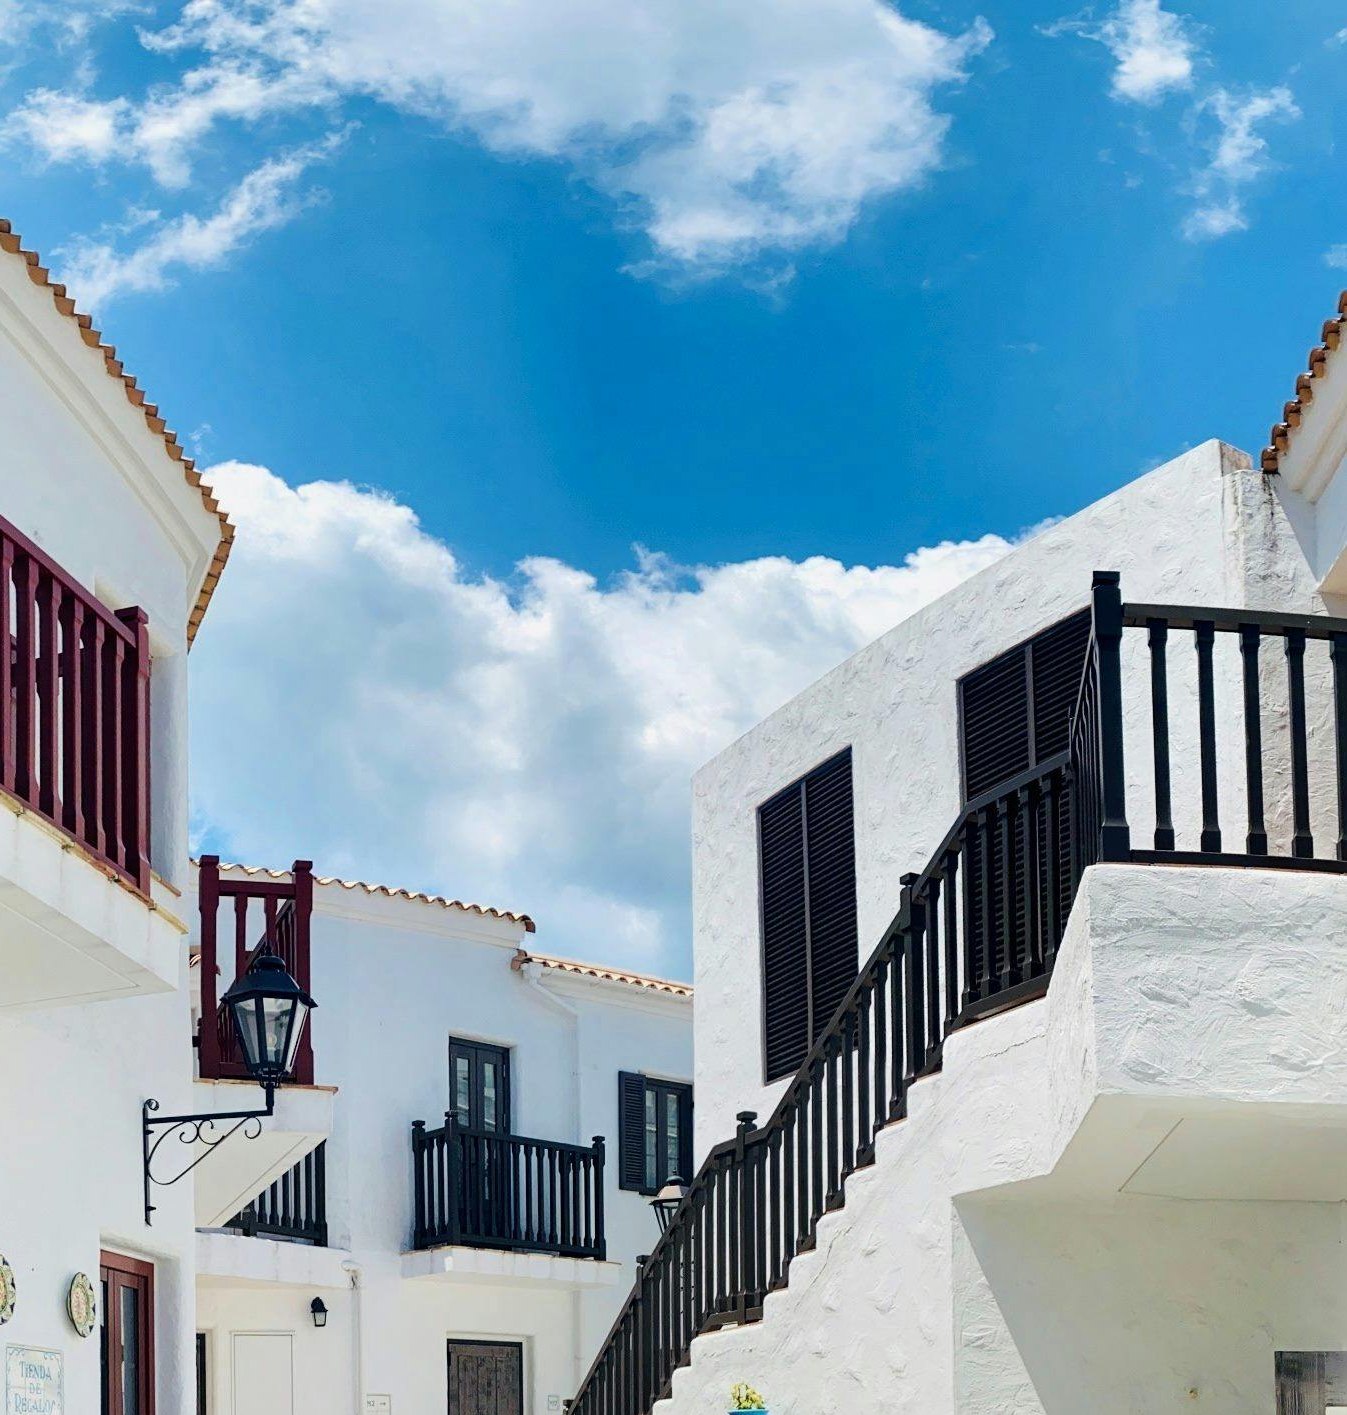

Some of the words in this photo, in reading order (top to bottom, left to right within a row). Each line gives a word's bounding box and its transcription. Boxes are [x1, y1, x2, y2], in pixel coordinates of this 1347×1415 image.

[19, 1360, 52, 1380] TIENDA
[29, 1383, 42, 1395] DE
[14, 1393, 56, 1415] REGALOS
